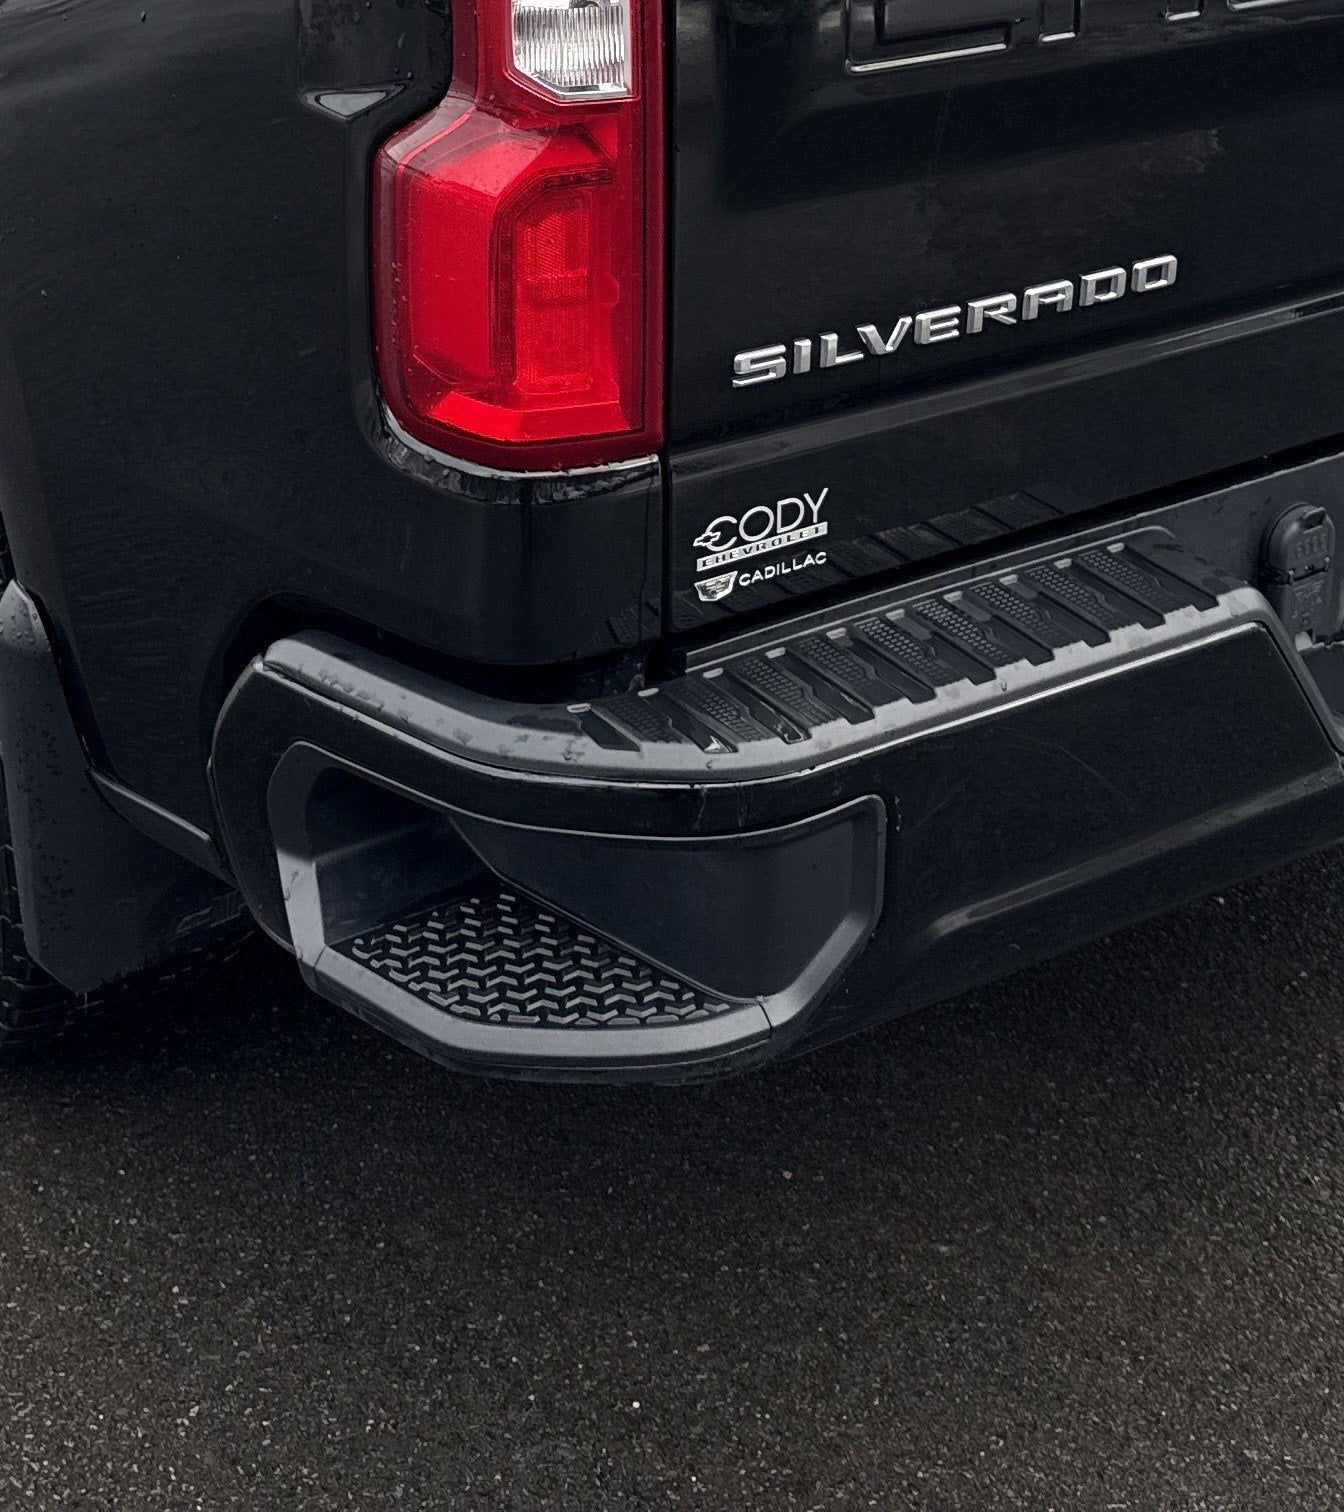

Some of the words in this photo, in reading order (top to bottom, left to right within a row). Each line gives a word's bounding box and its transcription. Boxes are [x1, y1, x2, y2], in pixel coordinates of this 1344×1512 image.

[731, 254, 1178, 388] SILVERADO
[699, 523, 826, 569] CHEVROLET
[701, 487, 829, 552] CODY
[738, 551, 828, 587] CADILLAC
